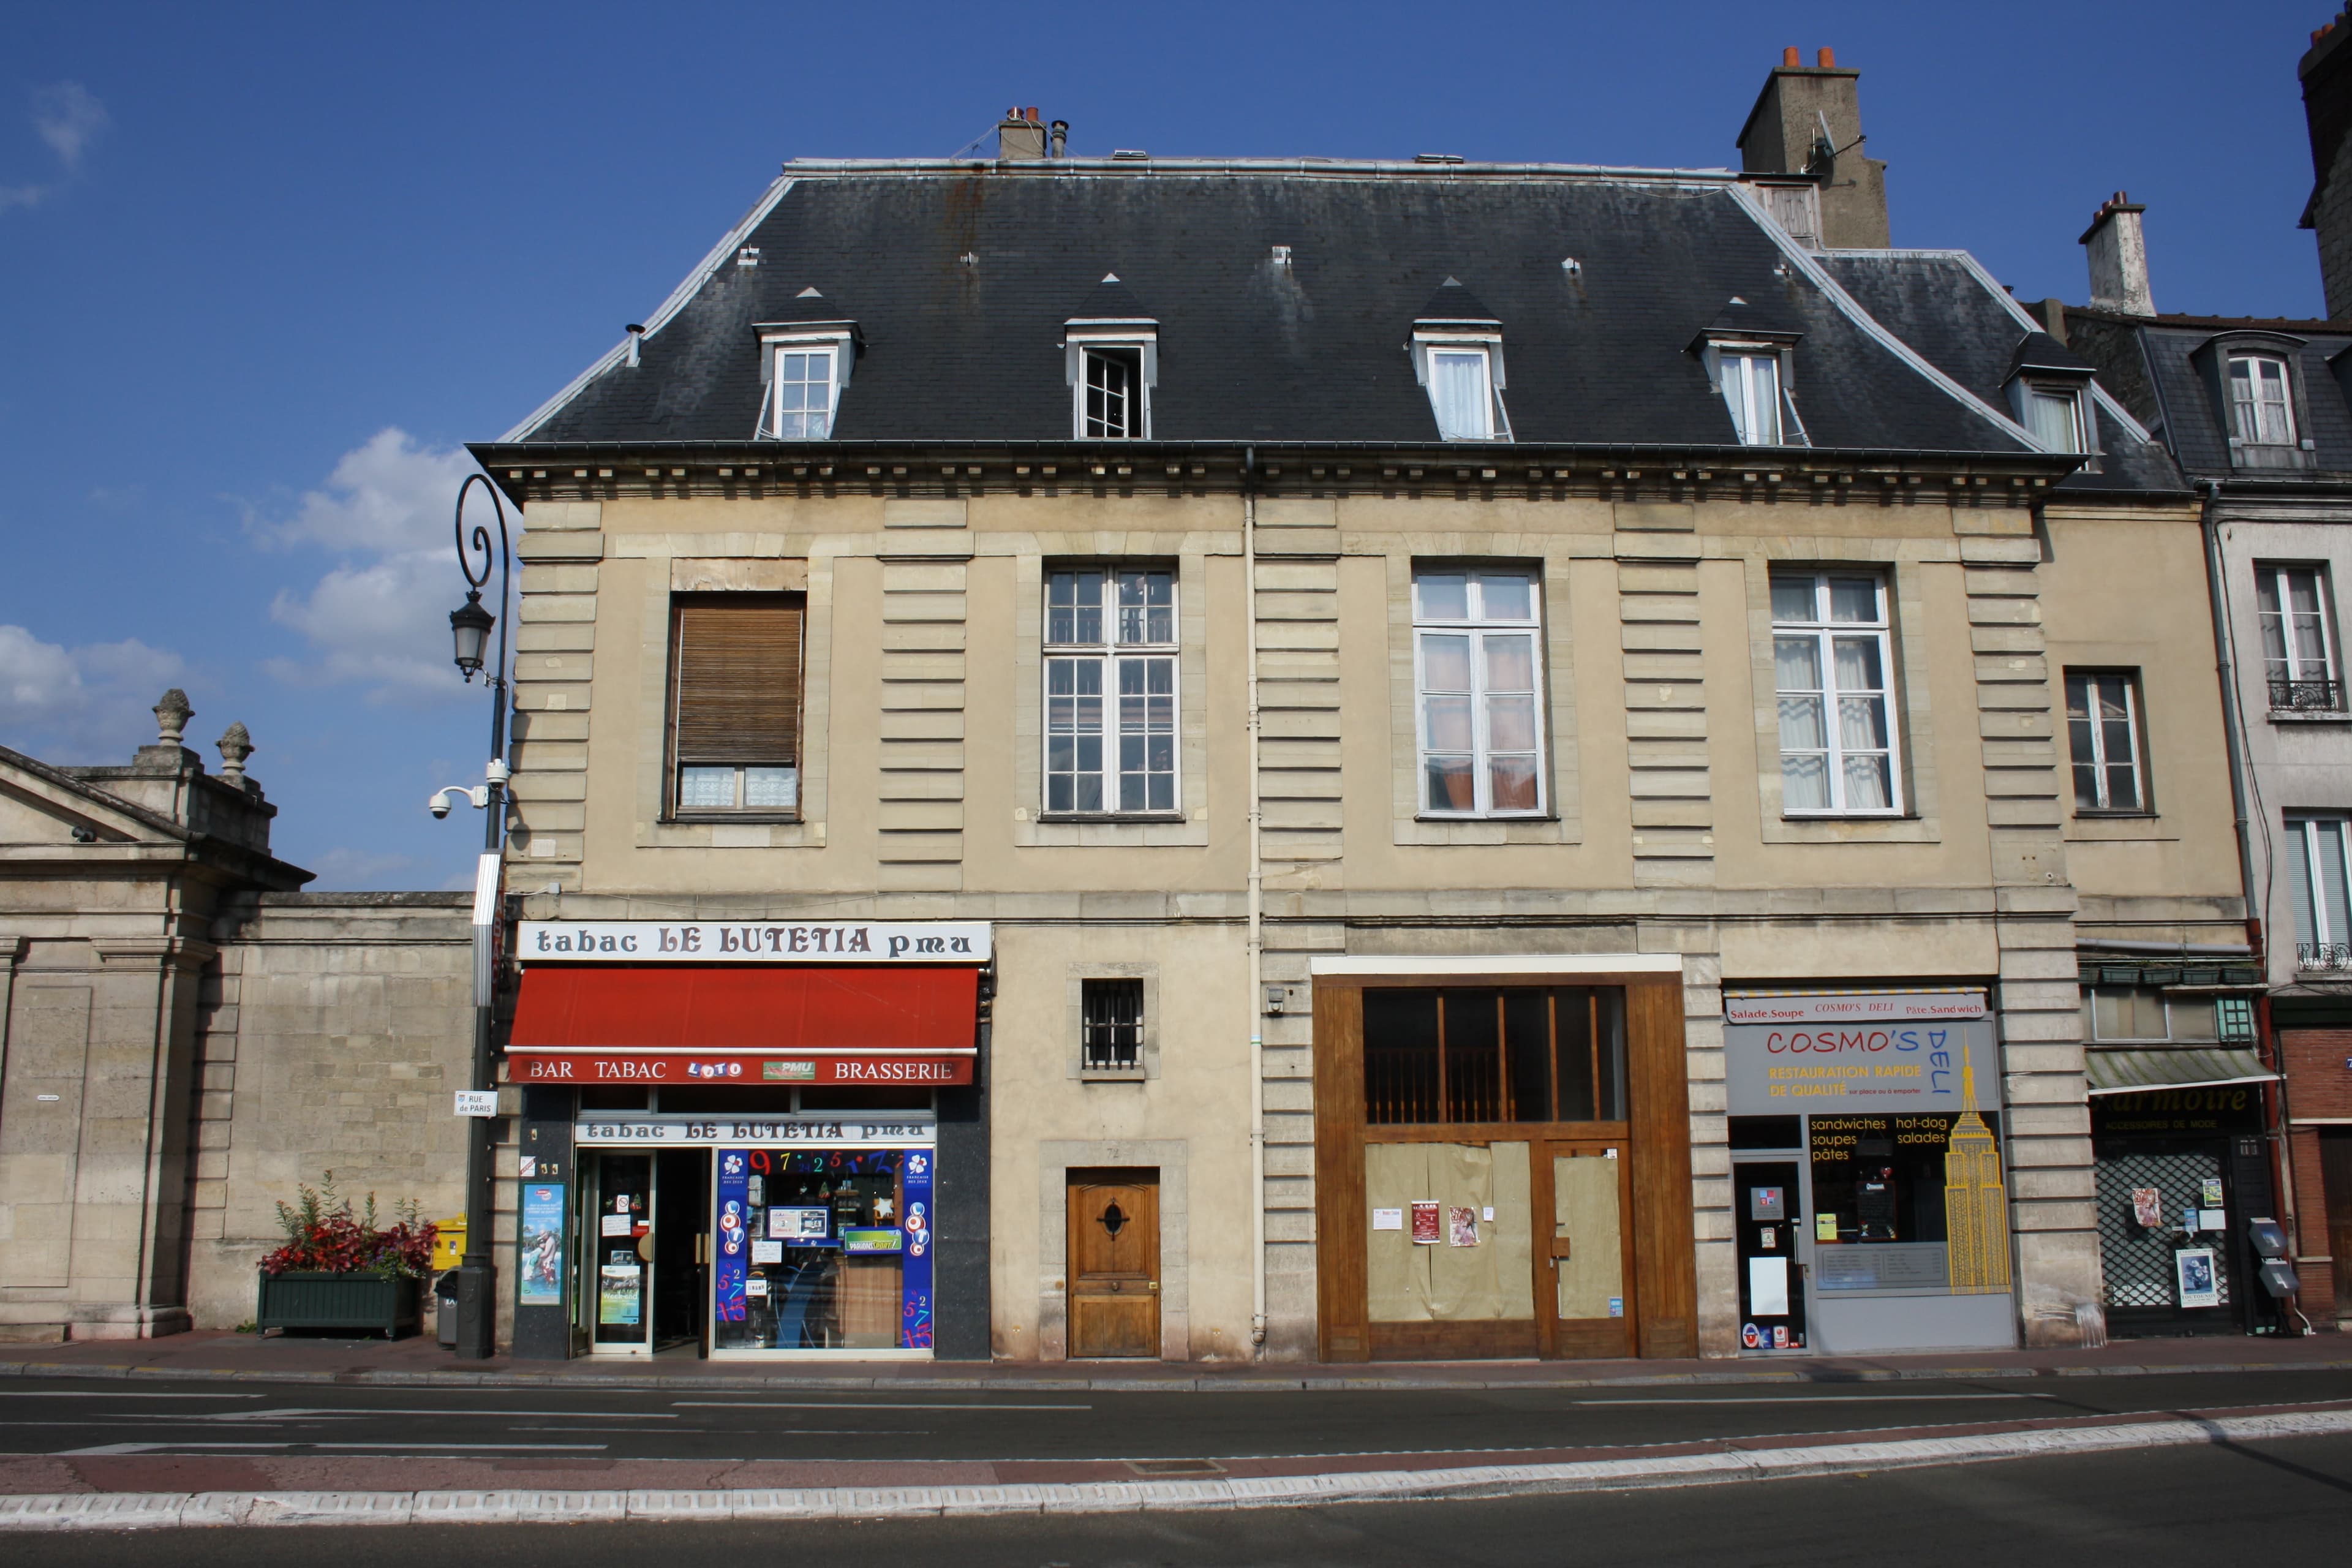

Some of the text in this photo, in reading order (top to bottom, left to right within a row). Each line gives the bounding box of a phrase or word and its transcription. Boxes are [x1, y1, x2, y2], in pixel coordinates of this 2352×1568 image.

[537, 927, 972, 958] tabac LE LUTETIA pmu
[1815, 1003, 1861, 1012] COSMO'S
[1868, 1003, 1894, 1011] DELI
[1767, 1030, 1919, 1054] COSMO'S
[1928, 1029, 1951, 1093] DELI
[530, 1061, 573, 1078] BAR
[595, 1061, 666, 1078] TABAC
[687, 1061, 743, 1079] LOTO
[782, 1063, 813, 1072] PMU
[835, 1063, 953, 1079] BRASSERIE
[1768, 1065, 1921, 1079] RESTAURATION RAPIDE
[1769, 1084, 1787, 1096] DE
[1790, 1080, 1847, 1096] QUALITÉ
[587, 1122, 925, 1139] tabac LE LUTETIA pmu
[1811, 1117, 1947, 1130] sandwiches hot-dog
[2106, 1119, 2218, 1131] ACCESSOIRES DE MODE
[1812, 1132, 1945, 1147] soupes salades
[749, 1150, 771, 1175] 9
[780, 1152, 791, 1170] 7
[814, 1157, 823, 1172] 2
[1812, 1149, 1849, 1161] pâtes
[721, 1201, 744, 1254] LOTO
[906, 1202, 929, 1256] LOTO
[718, 1273, 731, 1290] 5
[733, 1269, 741, 1280] 2
[729, 1283, 744, 1300] 7
[903, 1300, 916, 1317] 5
[919, 1295, 926, 1306] 2
[914, 1310, 930, 1327] 7
